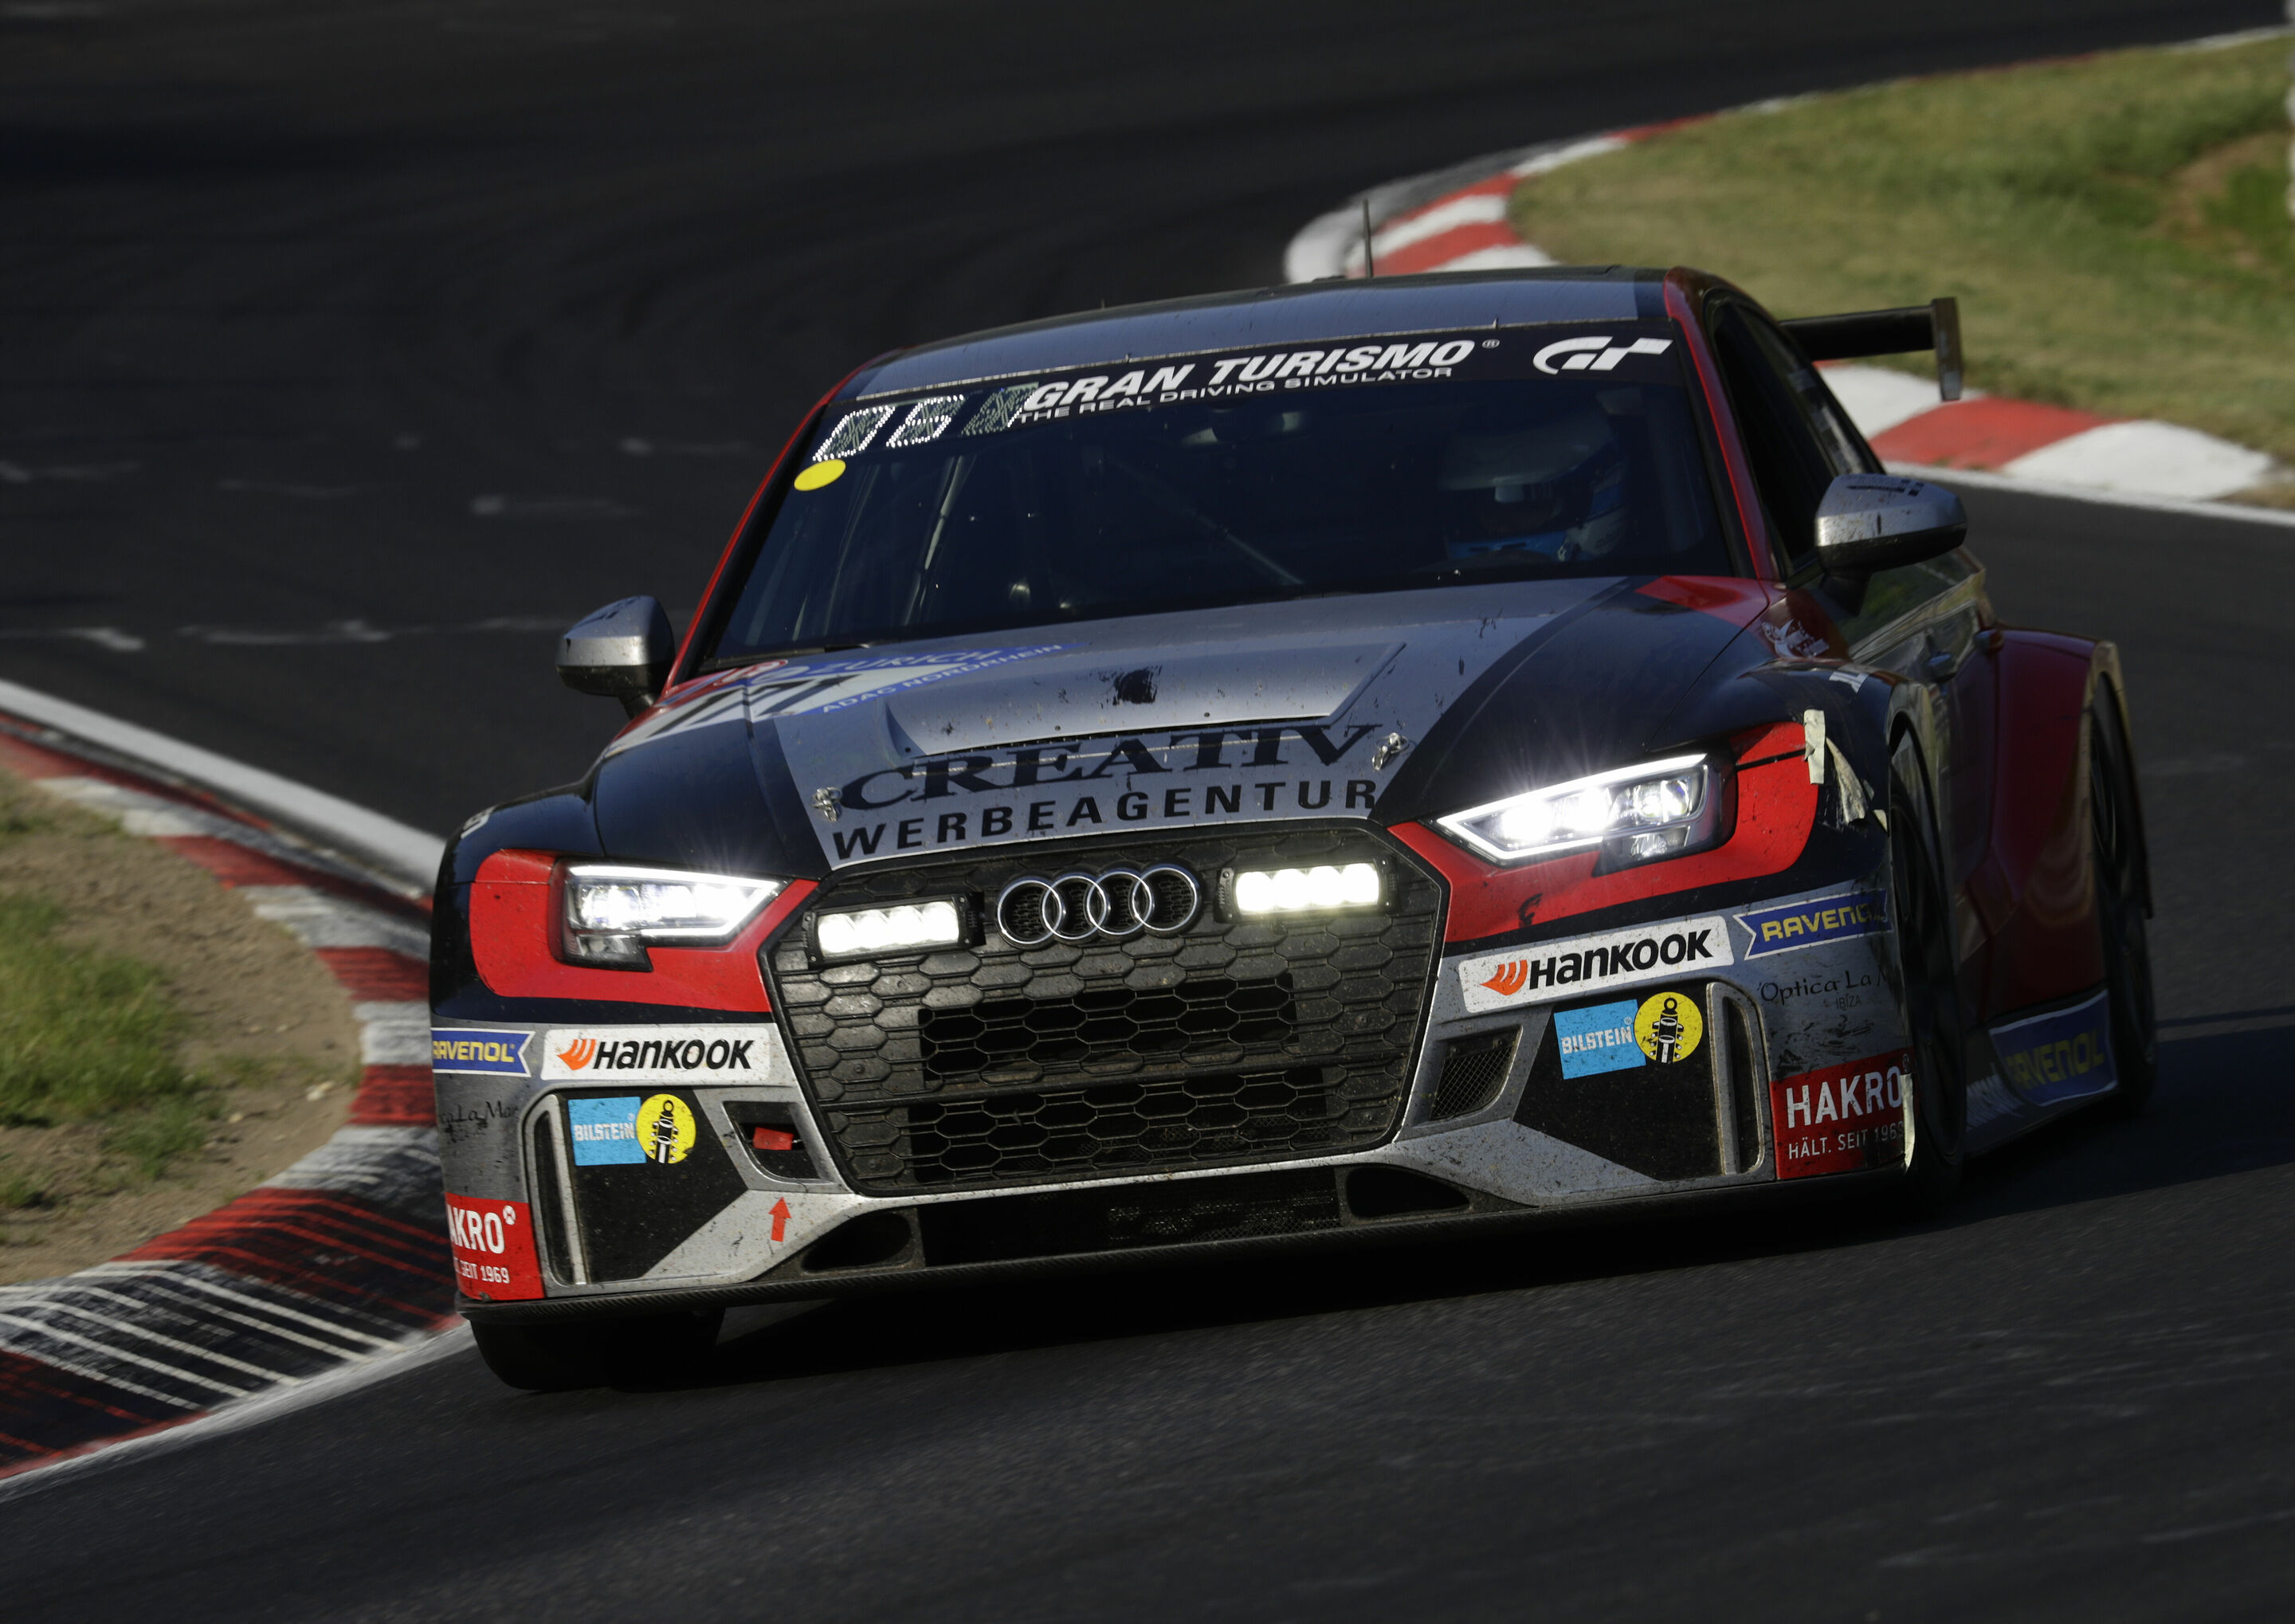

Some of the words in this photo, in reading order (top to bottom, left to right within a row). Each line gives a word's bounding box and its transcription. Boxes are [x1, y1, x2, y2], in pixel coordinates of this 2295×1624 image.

[1019, 409, 1070, 423] THE
[1079, 396, 1151, 414] REAL
[1159, 380, 1275, 402] DRIVING
[1285, 367, 1453, 389] SIMULATOR
[1024, 363, 1195, 411] GRAN
[1208, 340, 1475, 385] TURISMO
[823, 687, 896, 713] ADAC
[842, 724, 1384, 810] CREATIV
[833, 778, 1378, 861] WERBEAGENTUR
[1560, 1026, 1634, 1055] BILSTEIN
[1786, 1065, 1904, 1129] HAKRO
[573, 1121, 635, 1142] BILSTEIN
[1788, 1136, 1832, 1160] HÄLT.
[1837, 1128, 1869, 1152] SEIT
[480, 1265, 511, 1285] 1969
